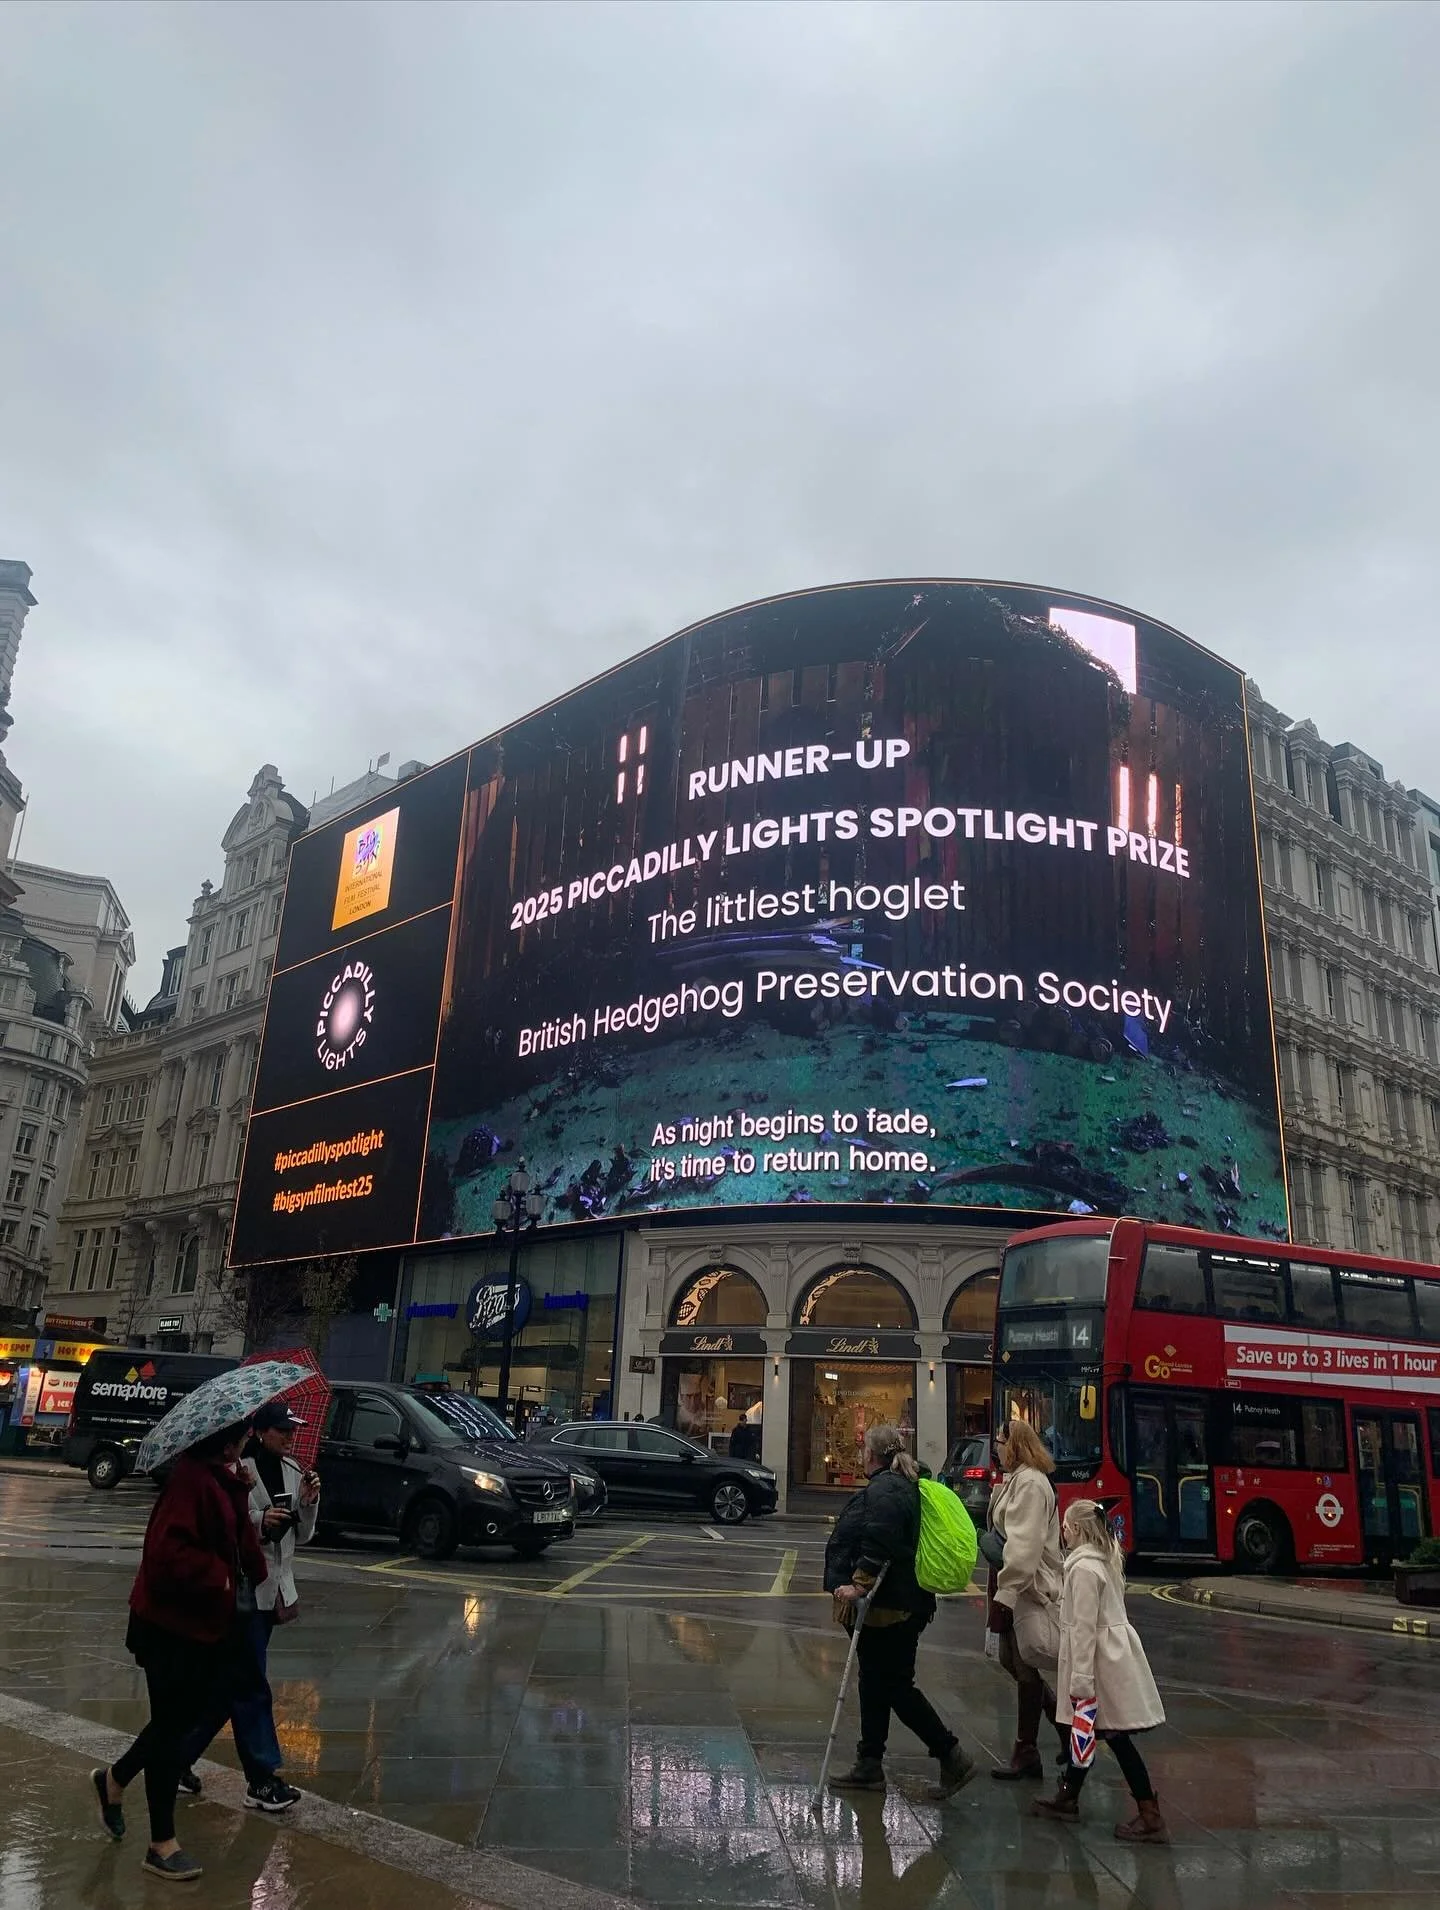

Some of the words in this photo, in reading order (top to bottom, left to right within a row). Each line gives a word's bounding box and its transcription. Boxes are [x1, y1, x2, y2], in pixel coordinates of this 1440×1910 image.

[689, 738, 910, 800] RUNNER-UP
[510, 886, 563, 930] 2025
[567, 831, 718, 909] PICCADILLY
[726, 810, 859, 855] LIGHTS
[870, 807, 1098, 851] SPOTLIGHT
[1106, 825, 1190, 878] PRIZE
[349, 900, 372, 914] LONDON
[648, 909, 696, 944] The
[706, 881, 815, 928] littlest
[829, 877, 966, 920] hoglet
[316, 961, 376, 1036] PICCADILLY
[518, 1013, 586, 1056] British
[593, 980, 744, 1033] Hedgehog
[757, 963, 1024, 1002] Preservation
[1037, 972, 1171, 1033] Society
[317, 1028, 367, 1070] LIGHTS
[652, 1122, 676, 1146] As
[682, 1115, 734, 1146] night
[740, 1110, 825, 1141] begins
[833, 1109, 858, 1133] to
[866, 1108, 937, 1138] fade,
[274, 1129, 384, 1174] #piccadillyspotlight
[650, 1157, 675, 1182] it's
[681, 1154, 726, 1178] time
[733, 1151, 755, 1173] to
[763, 1148, 840, 1172] return
[849, 1146, 936, 1172] home.
[272, 1174, 373, 1213] #bigsynfilmfest25
[10, 1343, 30, 1353] SPOT
[58, 1347, 77, 1355] HOT
[690, 1336, 724, 1352] Lindt
[826, 1337, 866, 1354] Lindt
[1072, 1326, 1089, 1346] 14
[1145, 1355, 1171, 1379] Go
[1236, 1346, 1273, 1364] Save
[1277, 1351, 1297, 1370] up
[1302, 1350, 1318, 1366] to
[1323, 1350, 1332, 1367] 3
[1337, 1350, 1369, 1369] lives
[1373, 1352, 1387, 1369] in
[1392, 1354, 1399, 1370] 1
[1404, 1353, 1437, 1372] hour
[91, 1381, 168, 1400] semaphore
[1232, 1402, 1242, 1413] 14
